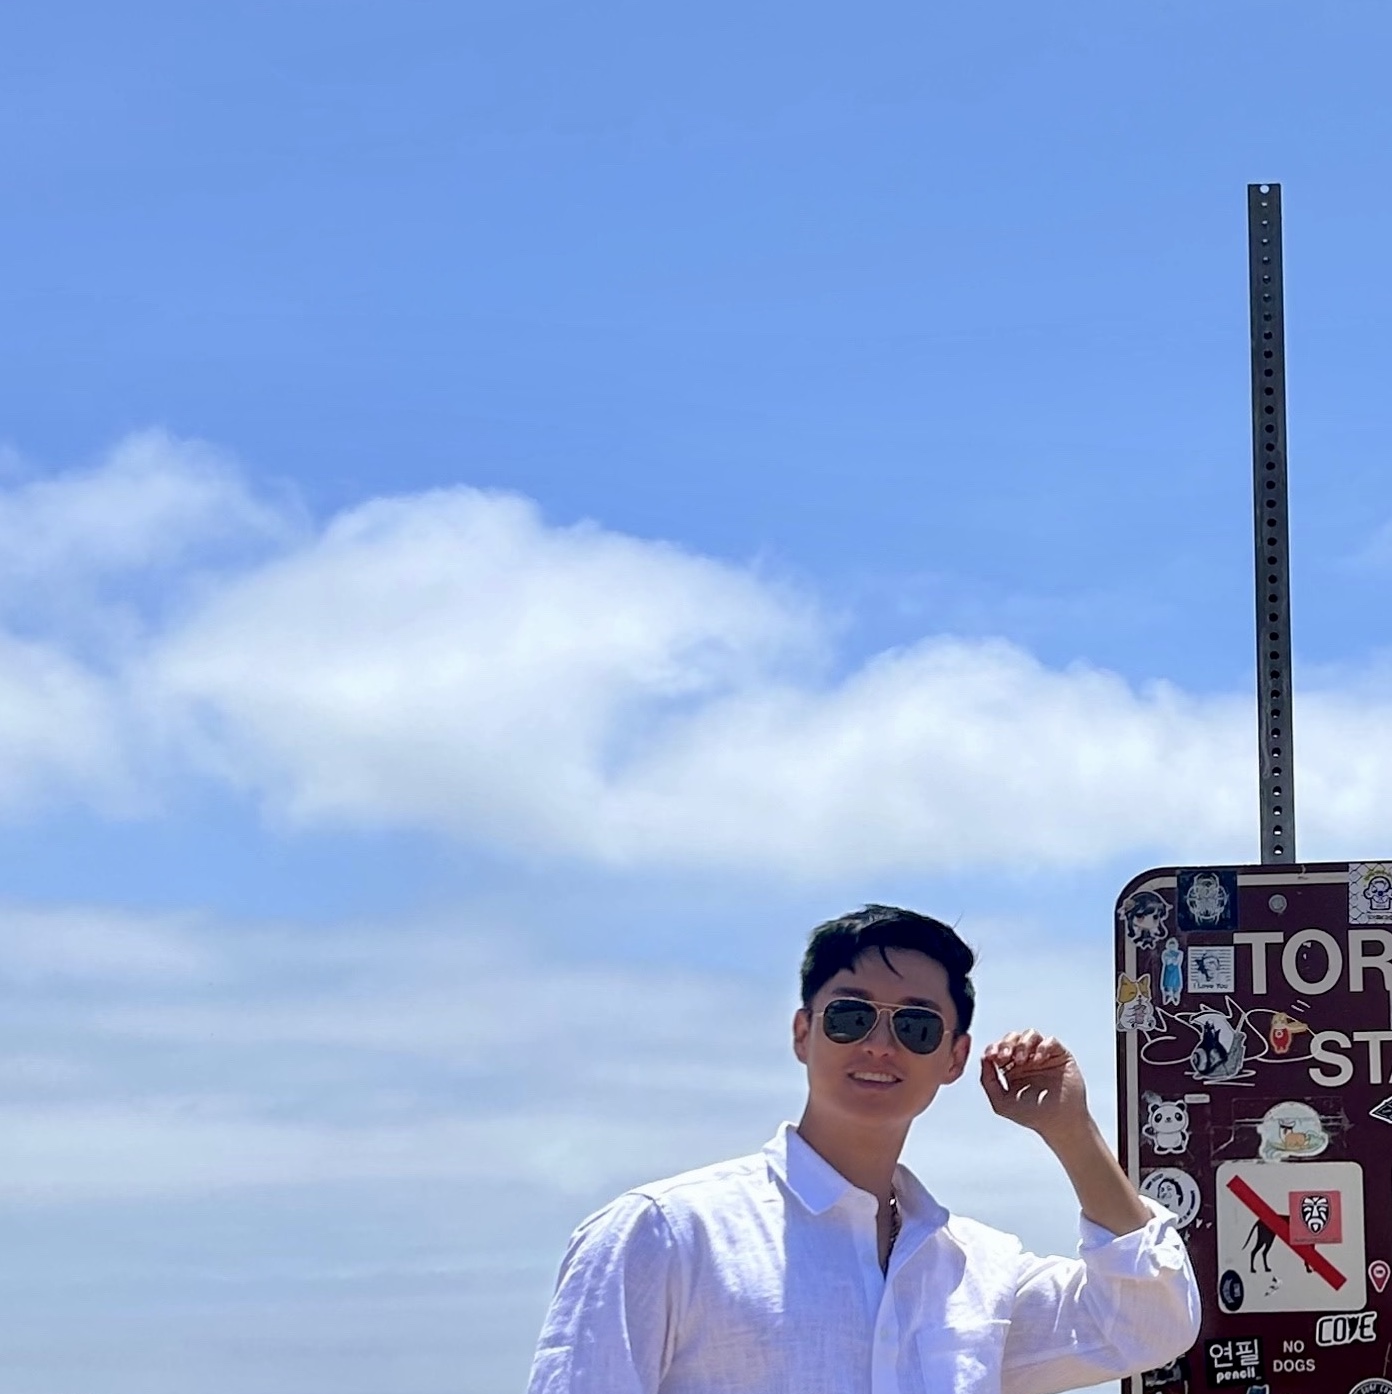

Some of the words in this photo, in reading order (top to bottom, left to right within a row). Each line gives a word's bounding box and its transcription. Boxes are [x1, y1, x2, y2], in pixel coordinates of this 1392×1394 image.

[1316, 1311, 1377, 1346] COVE
[1209, 1339, 1260, 1368] 연필
[1283, 1340, 1305, 1354] NO
[1273, 1359, 1316, 1373] DOGS
